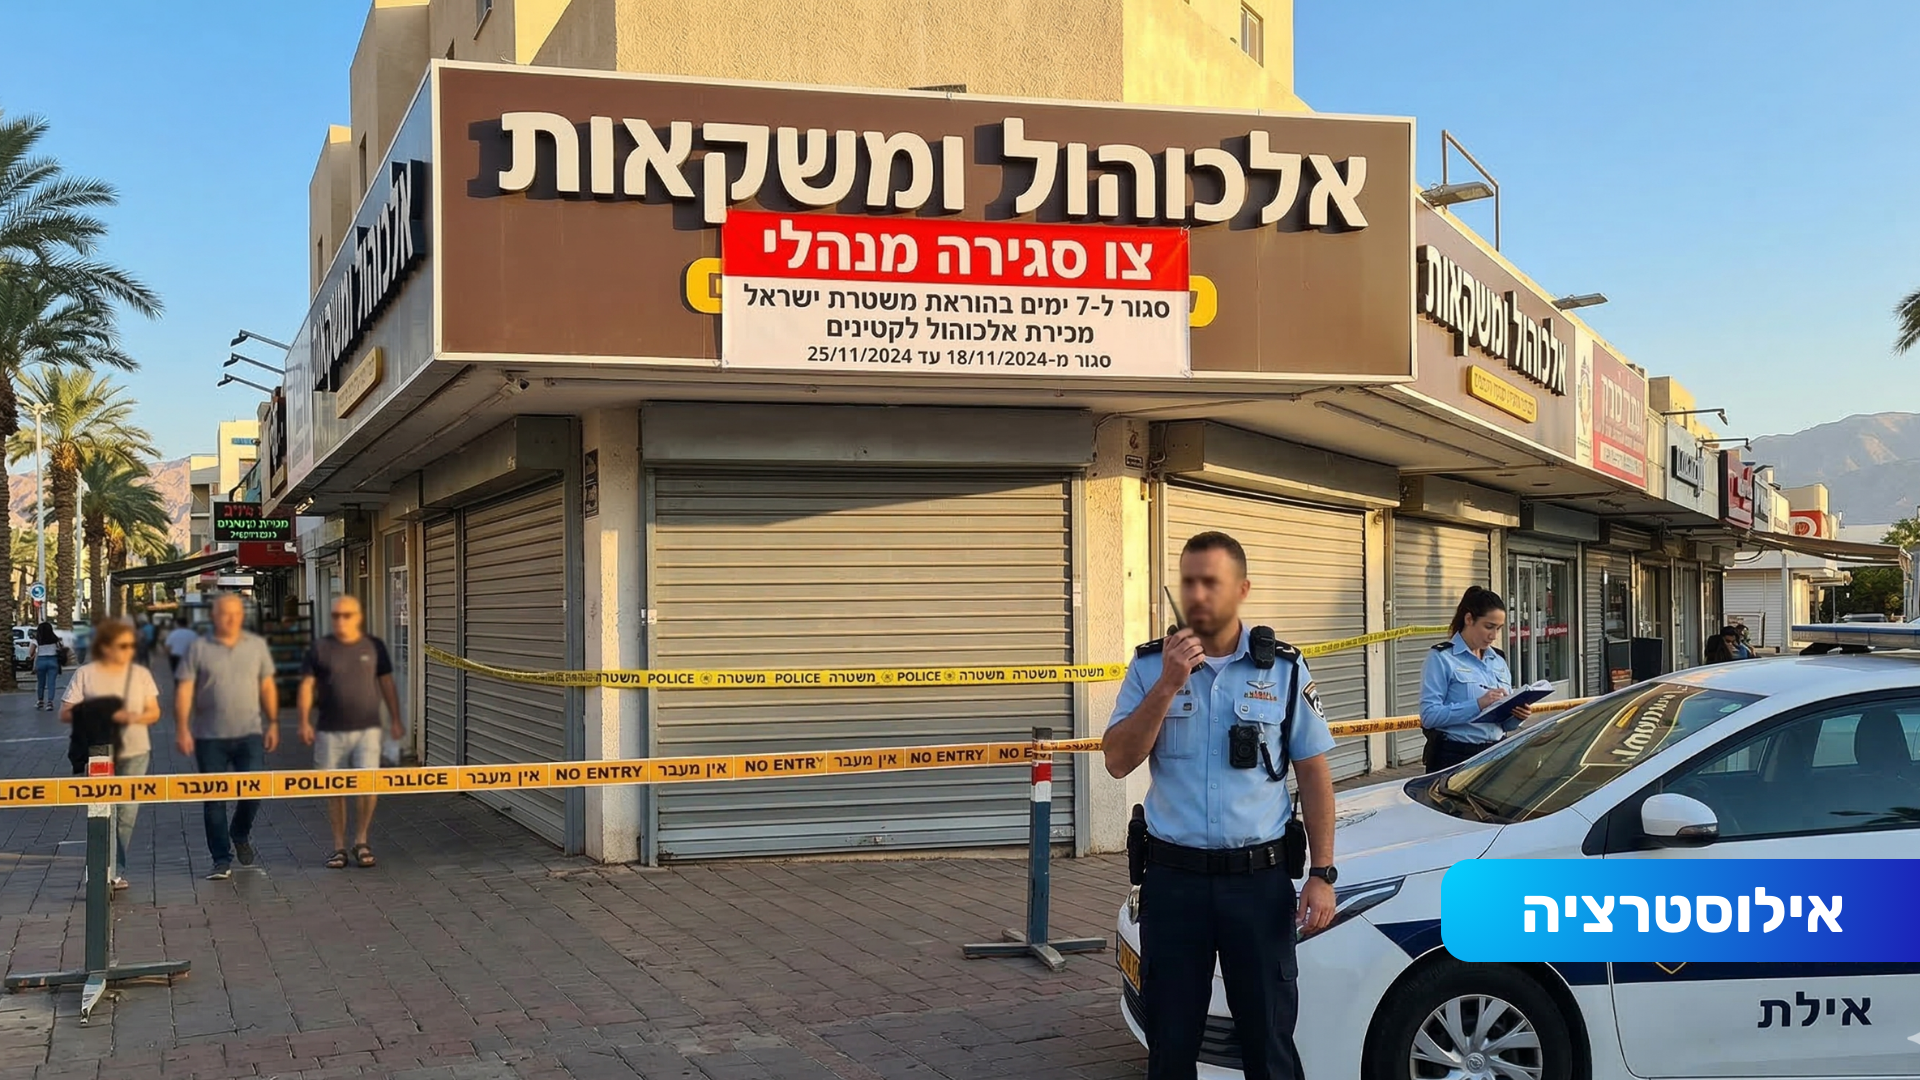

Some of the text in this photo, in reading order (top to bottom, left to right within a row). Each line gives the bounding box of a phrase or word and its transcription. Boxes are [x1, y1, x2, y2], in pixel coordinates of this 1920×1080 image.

[497, 110, 1370, 228] אלכוהול ומשקאות
[764, 220, 1152, 280] צו סגירה מנהלי
[744, 284, 819, 307] ישראל
[828, 291, 916, 310] משטרת
[1425, 245, 1509, 357] ומשקאות
[925, 294, 1013, 313] בהוראת
[1021, 297, 1068, 315] ימים
[1077, 295, 1113, 316] ל-7
[1121, 300, 1169, 318] סגור
[828, 317, 1093, 343] מכירת אלכוהול לקטינים
[1513, 290, 1568, 396] אלכוהול
[808, 346, 1111, 368] סגור מ-18/11/2024 עד 25/11/2024
[595, 673, 640, 685] משטרה
[648, 674, 694, 684] POLICE
[718, 674, 765, 683] משטרה
[776, 673, 820, 683] POLICE
[830, 673, 875, 682] משטרה
[898, 671, 941, 681] POLICE
[960, 671, 1004, 680] משטרה
[1013, 670, 1056, 679] משטרה
[1064, 668, 1104, 678] משטרה
[911, 750, 984, 763] NO ENTRY
[1000, 748, 1019, 758] NO
[746, 757, 823, 772] NO ENTRY
[834, 754, 896, 768] אין מעבר
[557, 766, 642, 780] NO ENTRY
[658, 763, 726, 778] אין מעבר
[285, 776, 357, 790] POLICE
[467, 771, 539, 786] אין מעבר
[69, 783, 156, 800] אין מעבר
[178, 780, 260, 797] אין מעבר
[1758, 992, 1871, 1028] אילת
